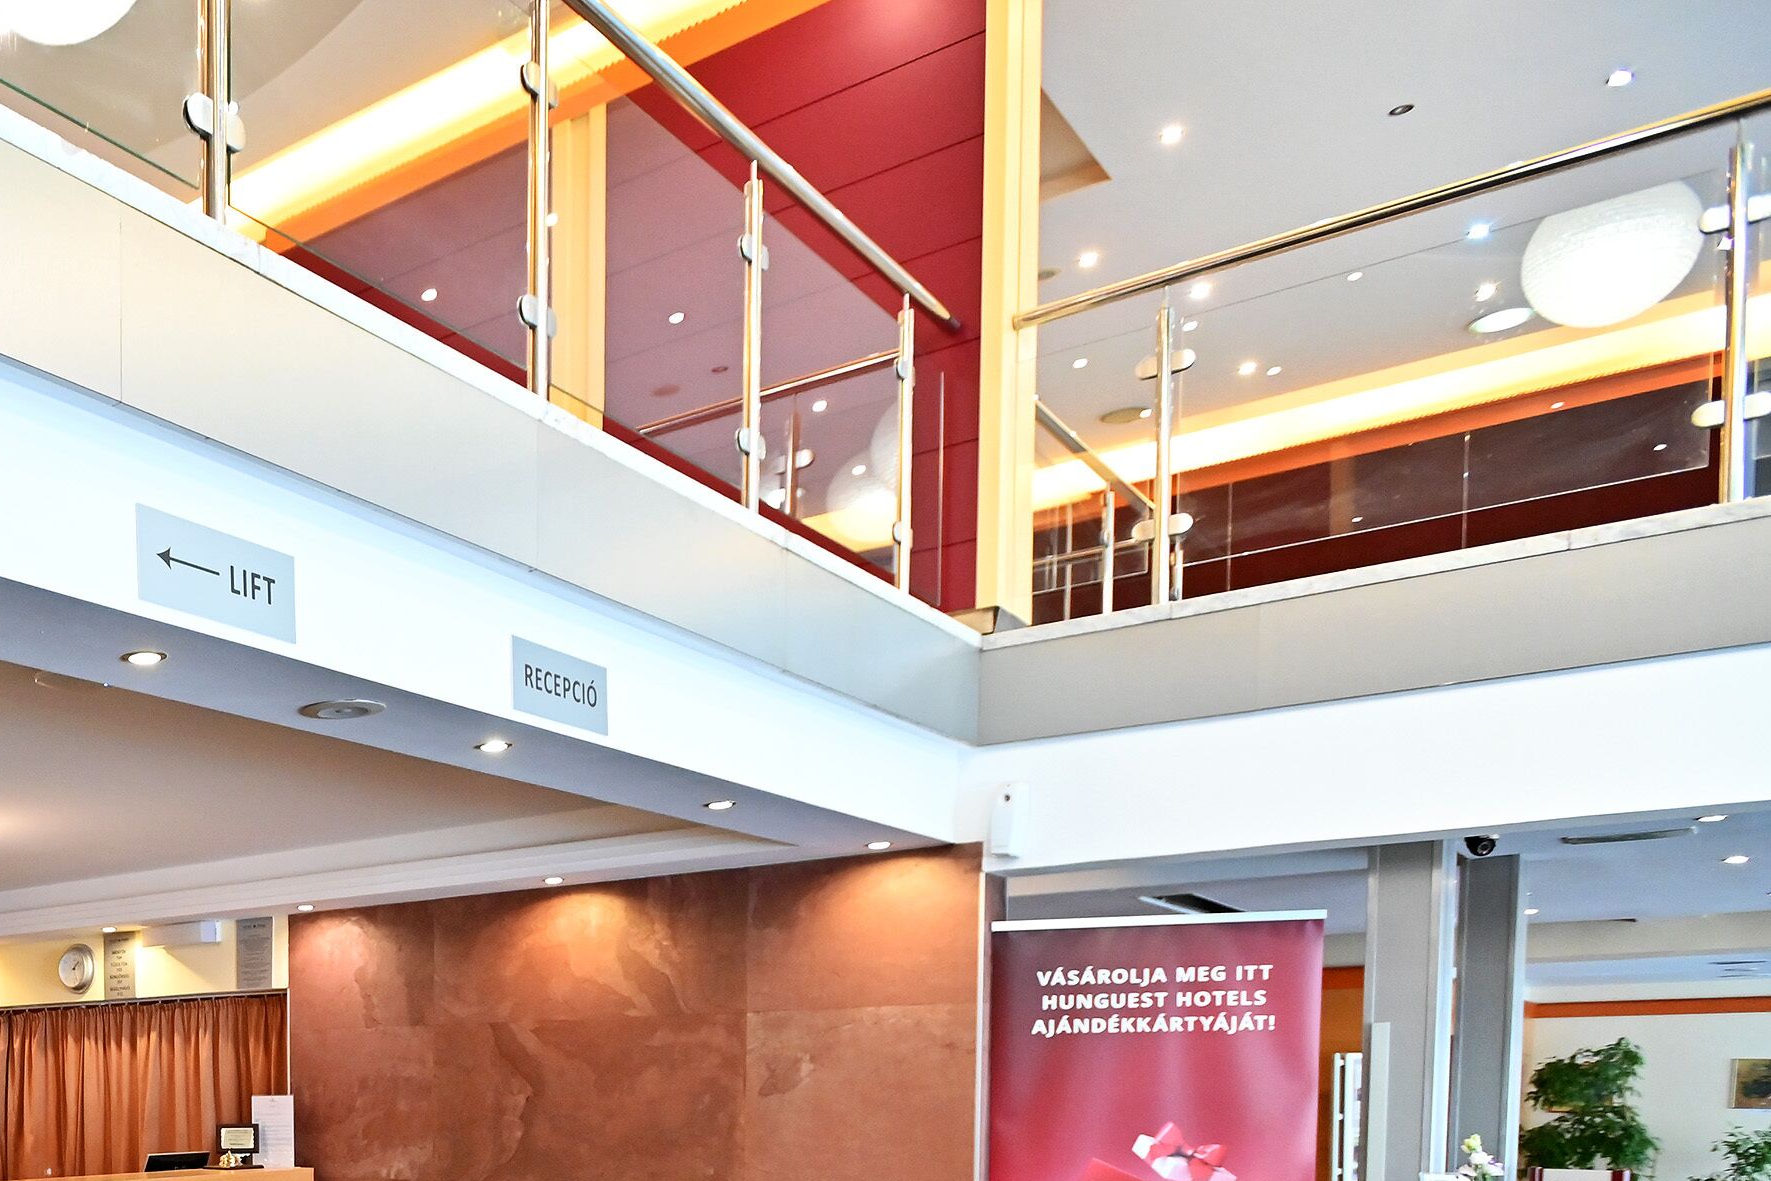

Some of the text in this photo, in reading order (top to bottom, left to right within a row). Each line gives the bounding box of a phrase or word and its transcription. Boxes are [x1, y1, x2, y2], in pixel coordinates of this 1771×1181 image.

[230, 564, 276, 606] LIFT
[524, 663, 597, 708] RECEPCIÓ
[1036, 964, 1274, 987] VÁSÁROLJA MEG ITT
[1041, 989, 1267, 1010] HUNGUEST HOTELS
[1030, 1012, 1276, 1038] AJÁNDÉKKÁRTYÁJÁT!
